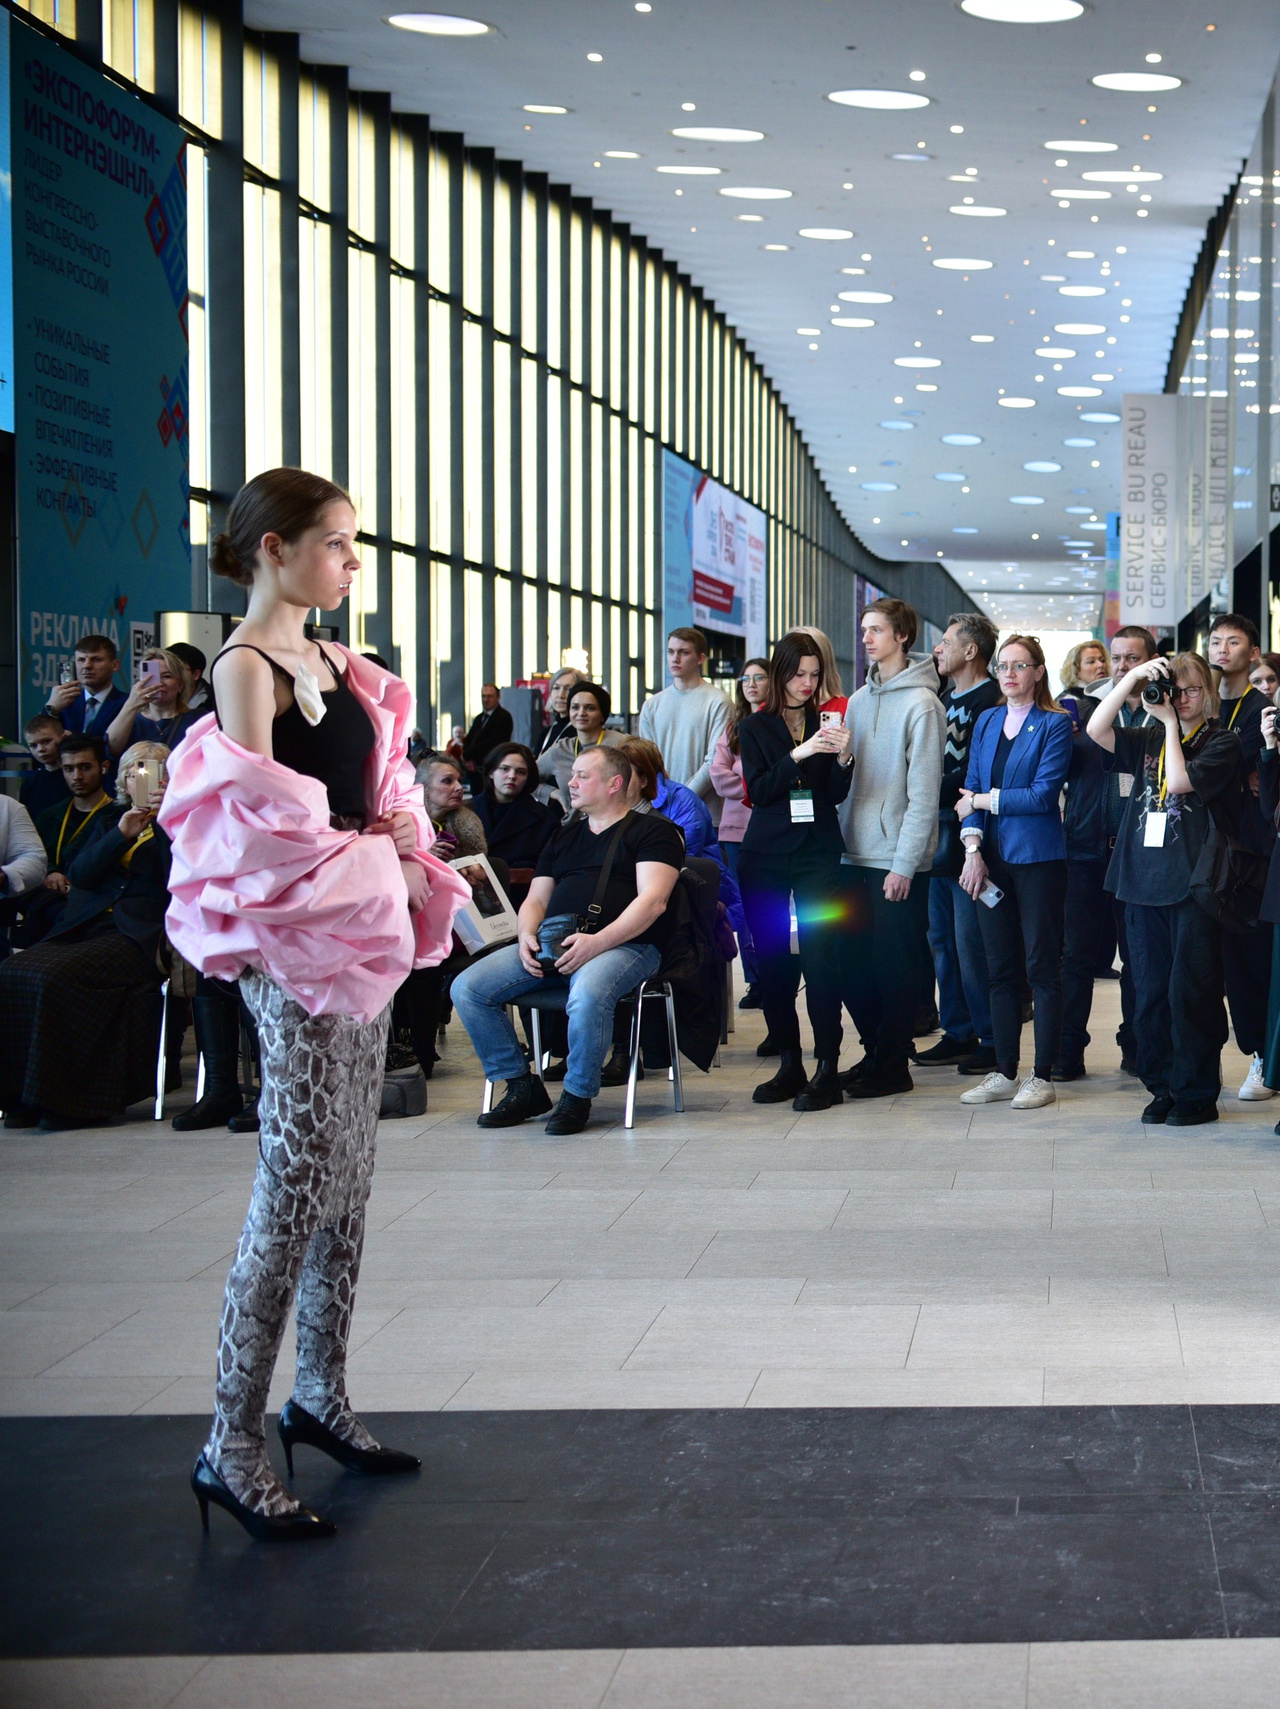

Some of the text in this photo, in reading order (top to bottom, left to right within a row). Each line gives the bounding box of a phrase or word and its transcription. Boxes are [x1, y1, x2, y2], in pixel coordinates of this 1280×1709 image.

[23, 148, 63, 182] ЛИДЕР
[32, 316, 111, 365] УНИКАЛЬНЫЕ
[34, 351, 90, 388] СОБЫТИЯ
[34, 384, 111, 428] ПОЗИТИВНЫЕ
[35, 418, 114, 460] ВПЕЧАТЛЕНИЯ
[35, 452, 118, 493] ЭФФЕКТИВНЫЕ
[36, 486, 97, 519] КОНТАКТЫ
[1125, 512, 1146, 609] SERVICE
[1149, 472, 1168, 609] СЕРВИС-БЮРО
